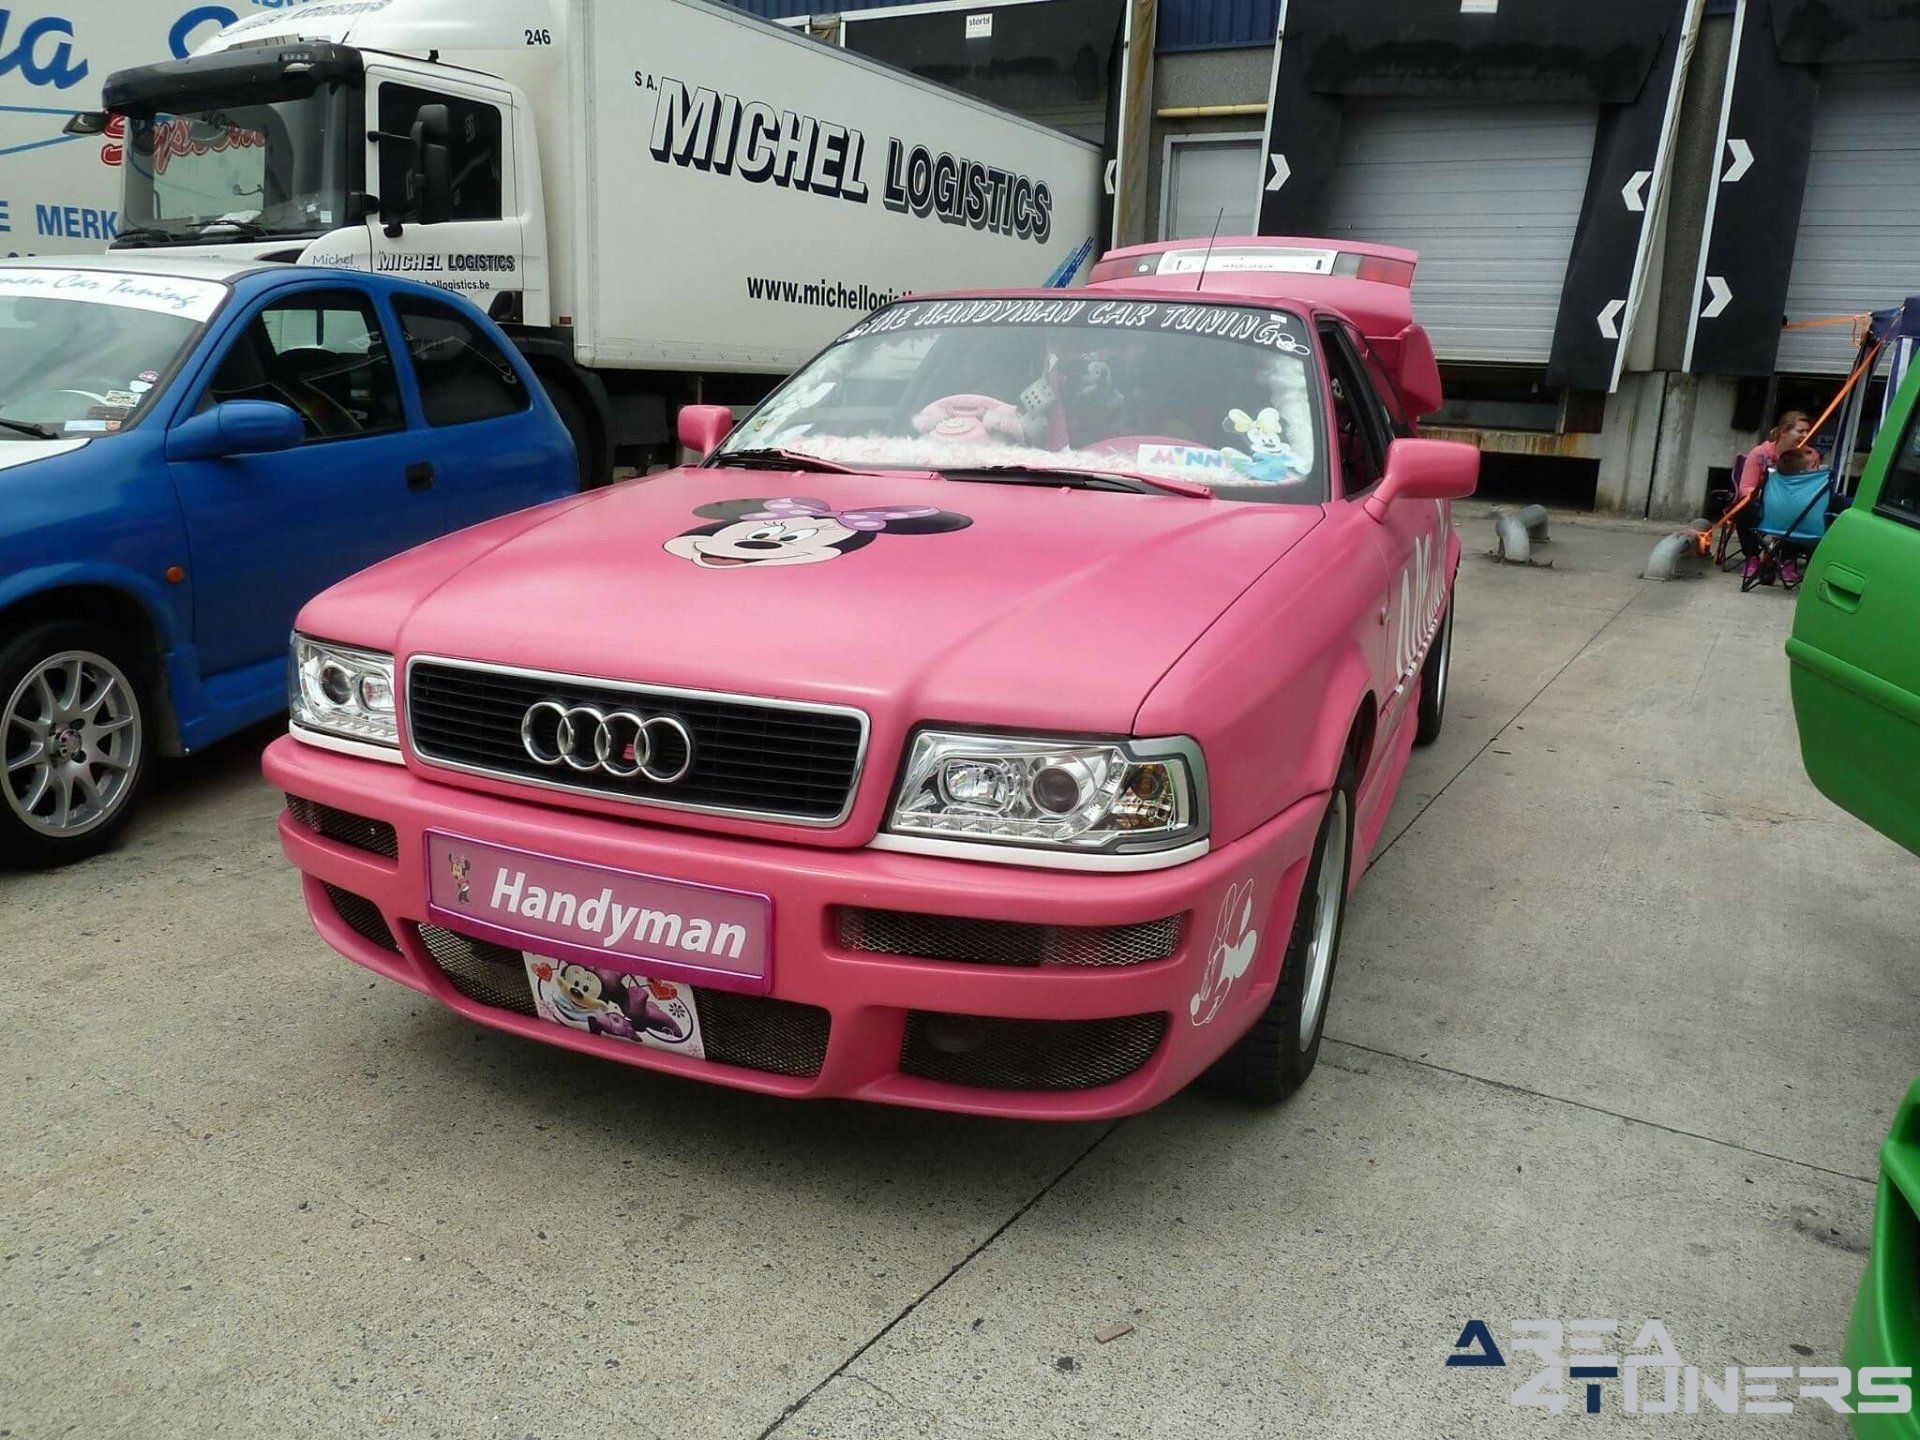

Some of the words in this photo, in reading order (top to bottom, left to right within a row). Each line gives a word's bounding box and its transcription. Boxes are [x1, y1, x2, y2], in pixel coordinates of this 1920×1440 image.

[524, 29, 552, 45] 246
[650, 76, 869, 204] MICHEL
[883, 136, 1052, 244] LOGISTICS
[376, 253, 443, 271] MICHEL
[447, 254, 515, 272] LOGISTICS
[913, 300, 1086, 326] HANDYMAN
[1087, 301, 1157, 326] CAR
[1160, 306, 1281, 345] TUNING
[490, 867, 747, 958] Handyman
